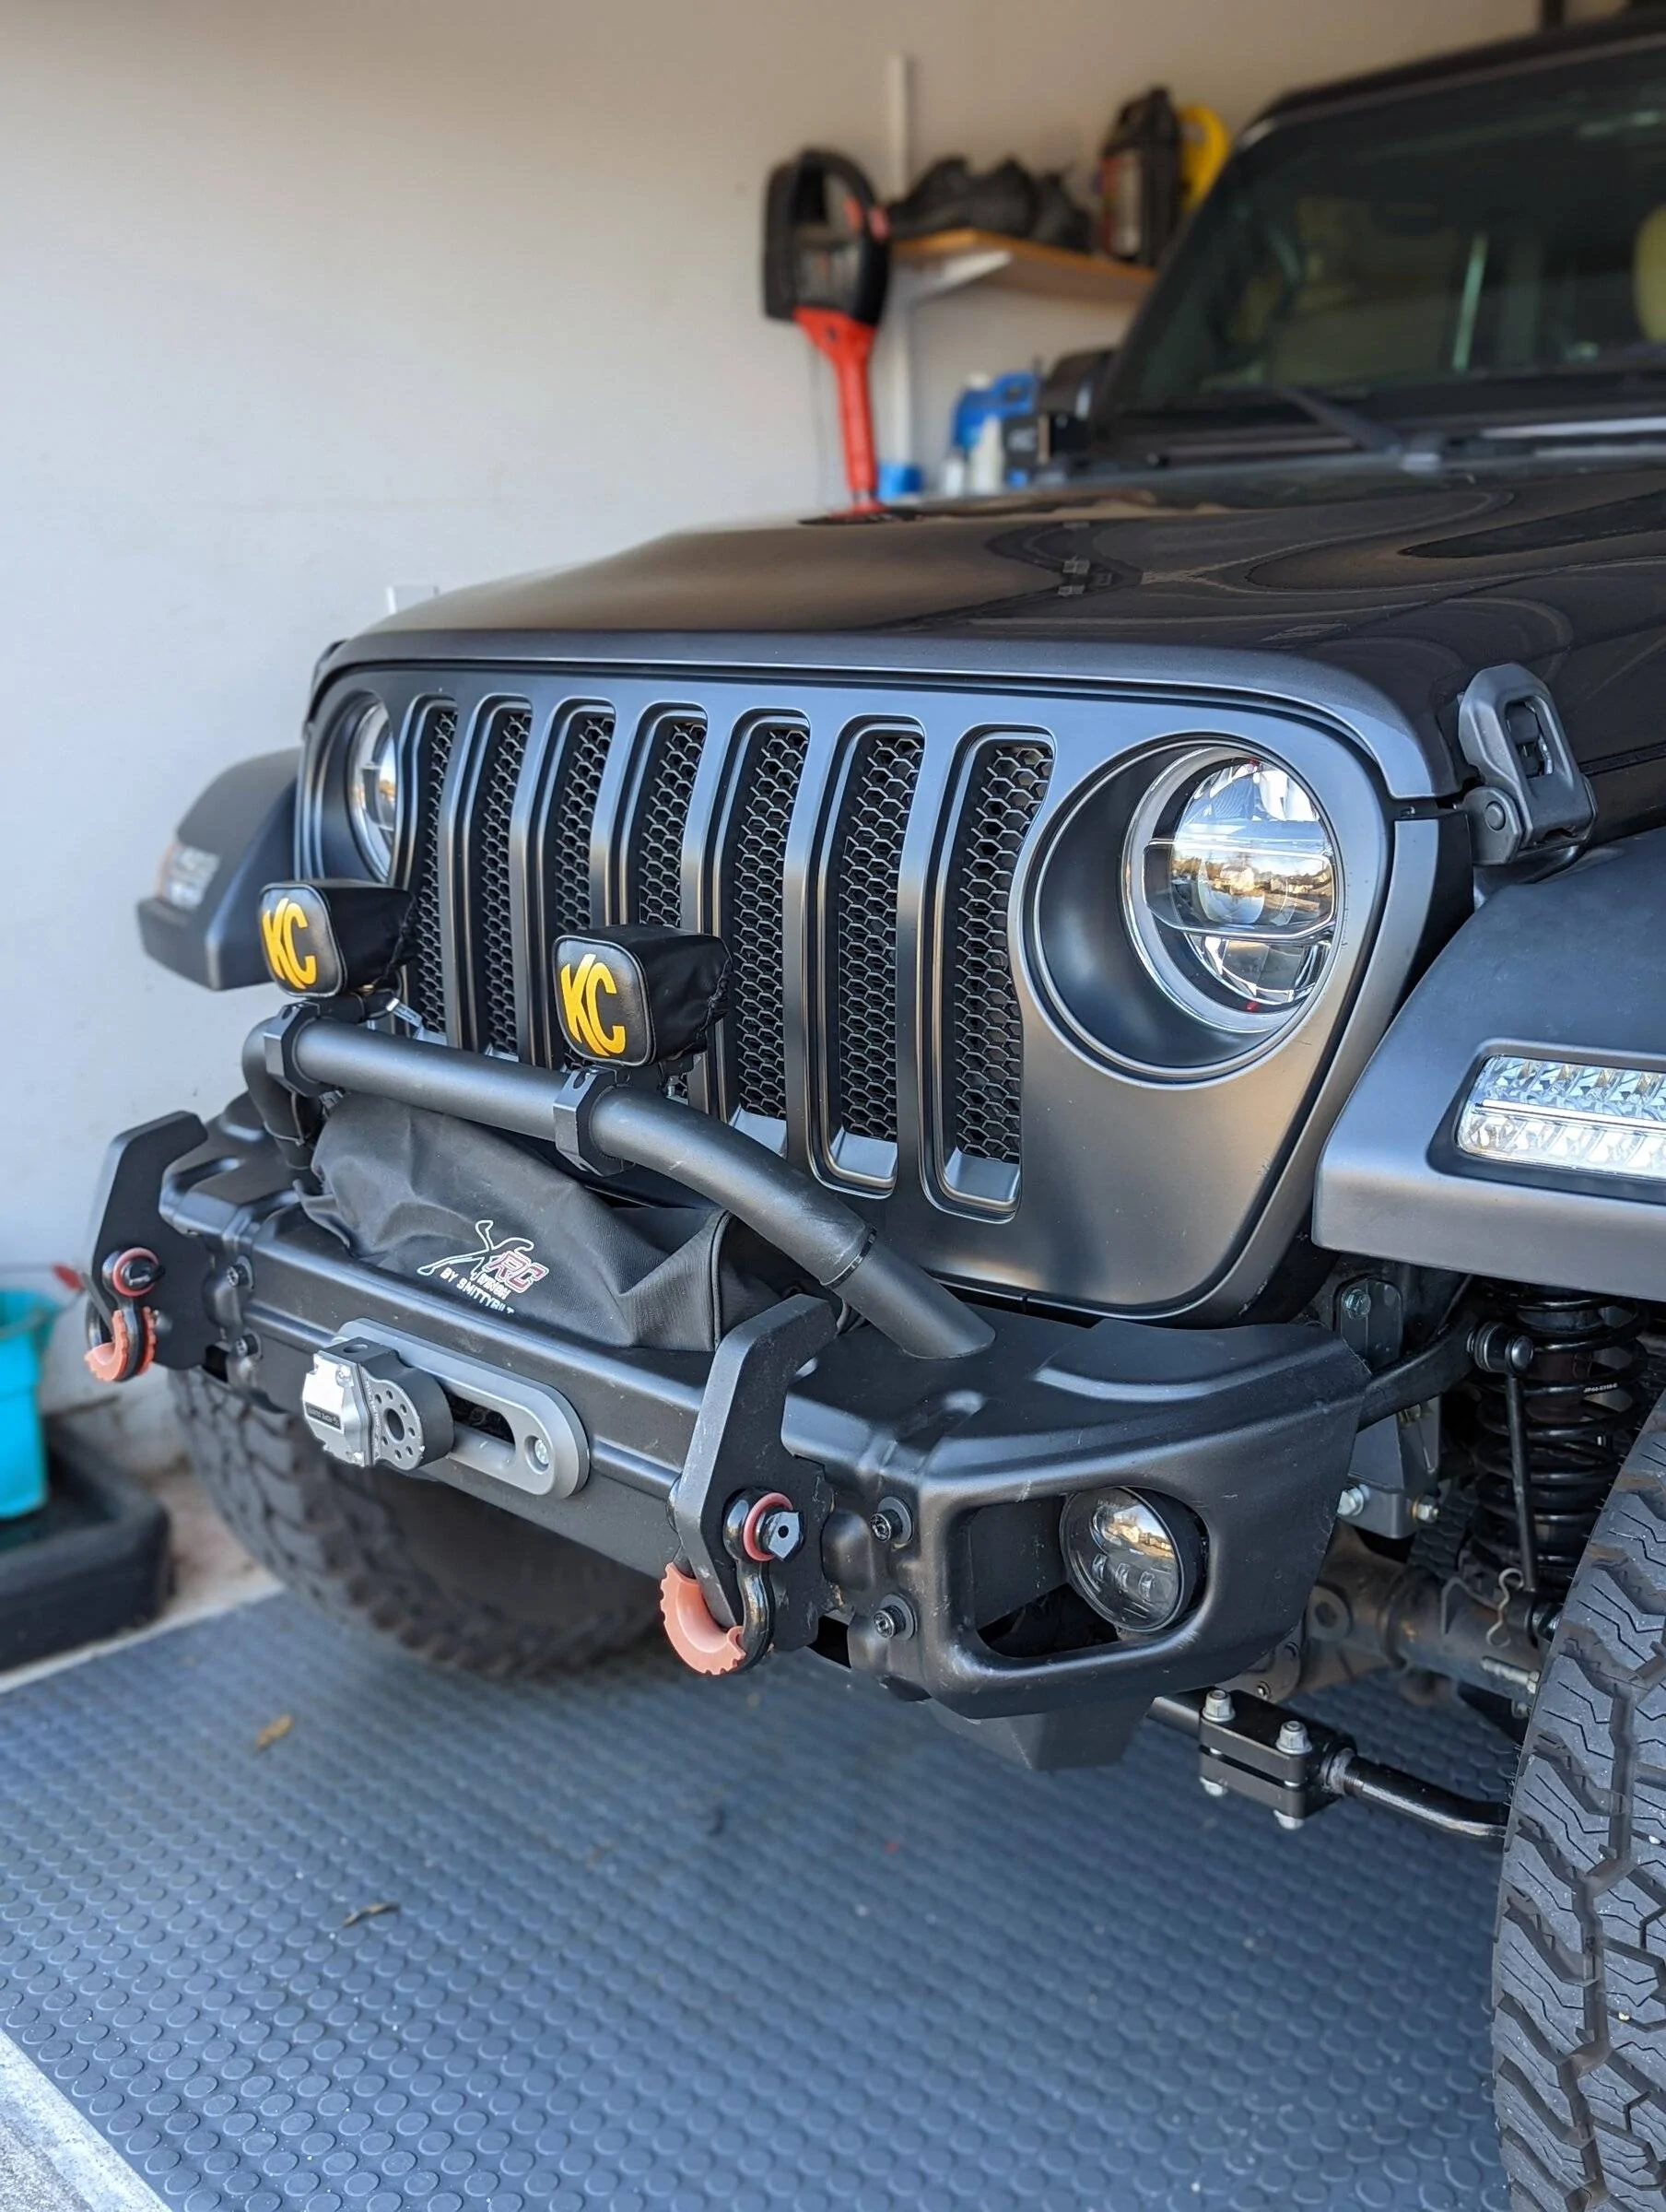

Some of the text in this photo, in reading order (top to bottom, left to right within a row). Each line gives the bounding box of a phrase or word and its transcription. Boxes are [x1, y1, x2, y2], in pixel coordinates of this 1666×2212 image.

[262, 897, 317, 990] KC
[560, 953, 627, 1057] KC
[440, 1266, 459, 1283] BY
